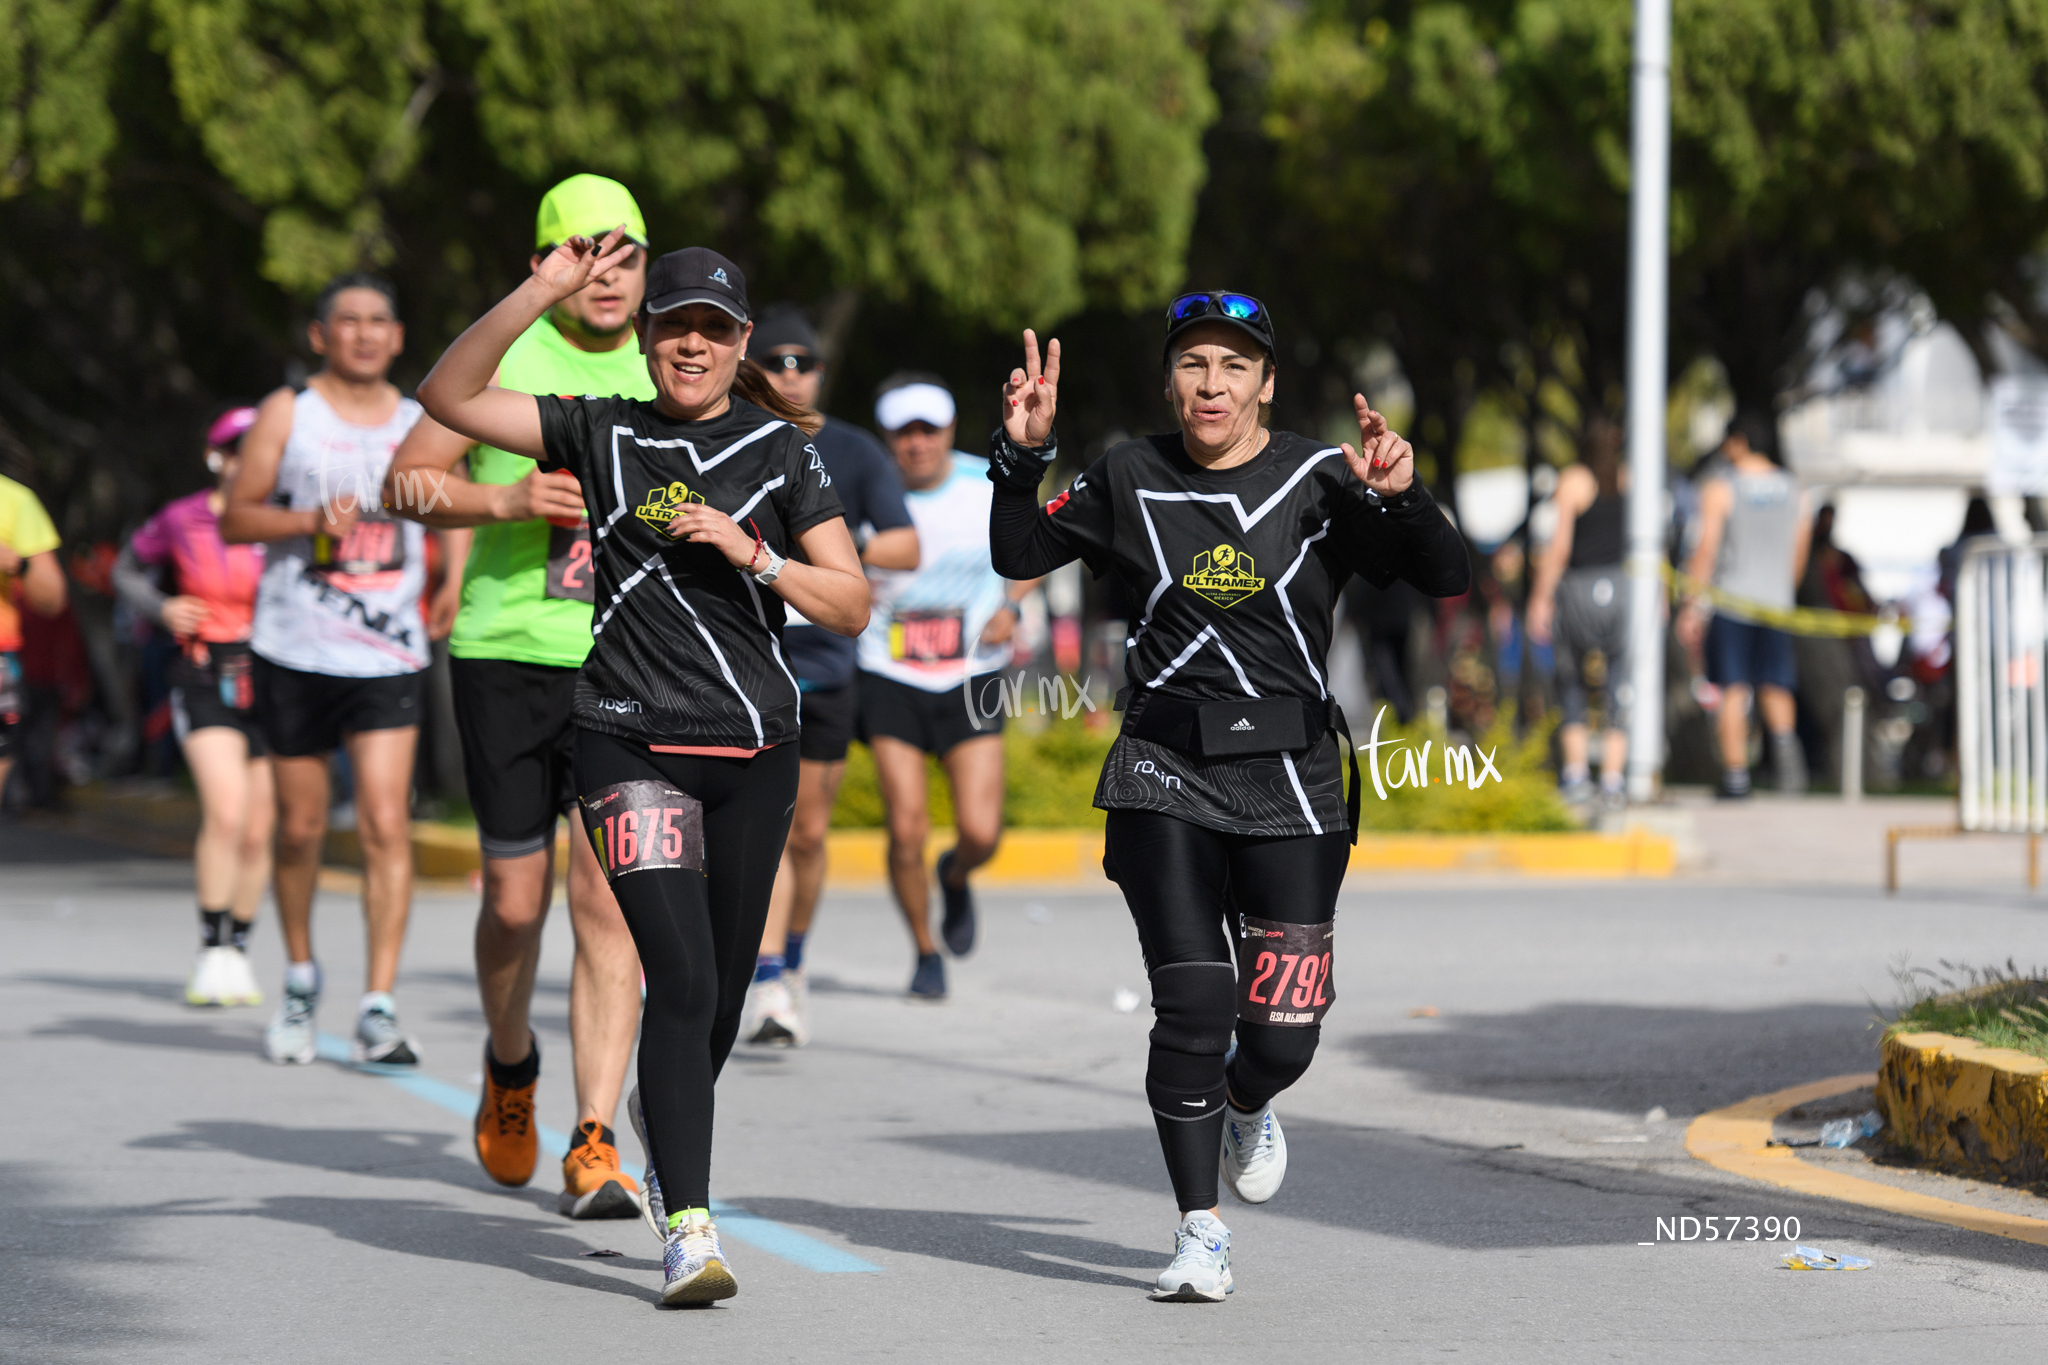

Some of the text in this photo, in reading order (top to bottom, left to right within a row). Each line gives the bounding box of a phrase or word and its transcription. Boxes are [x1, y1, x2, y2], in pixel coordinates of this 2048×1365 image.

[638, 507, 681, 520] ULTRA
[562, 540, 595, 588] 2
[1186, 577, 1263, 588] ULTRAMEX
[605, 808, 683, 871] 1675
[1248, 951, 1331, 1009] 2792
